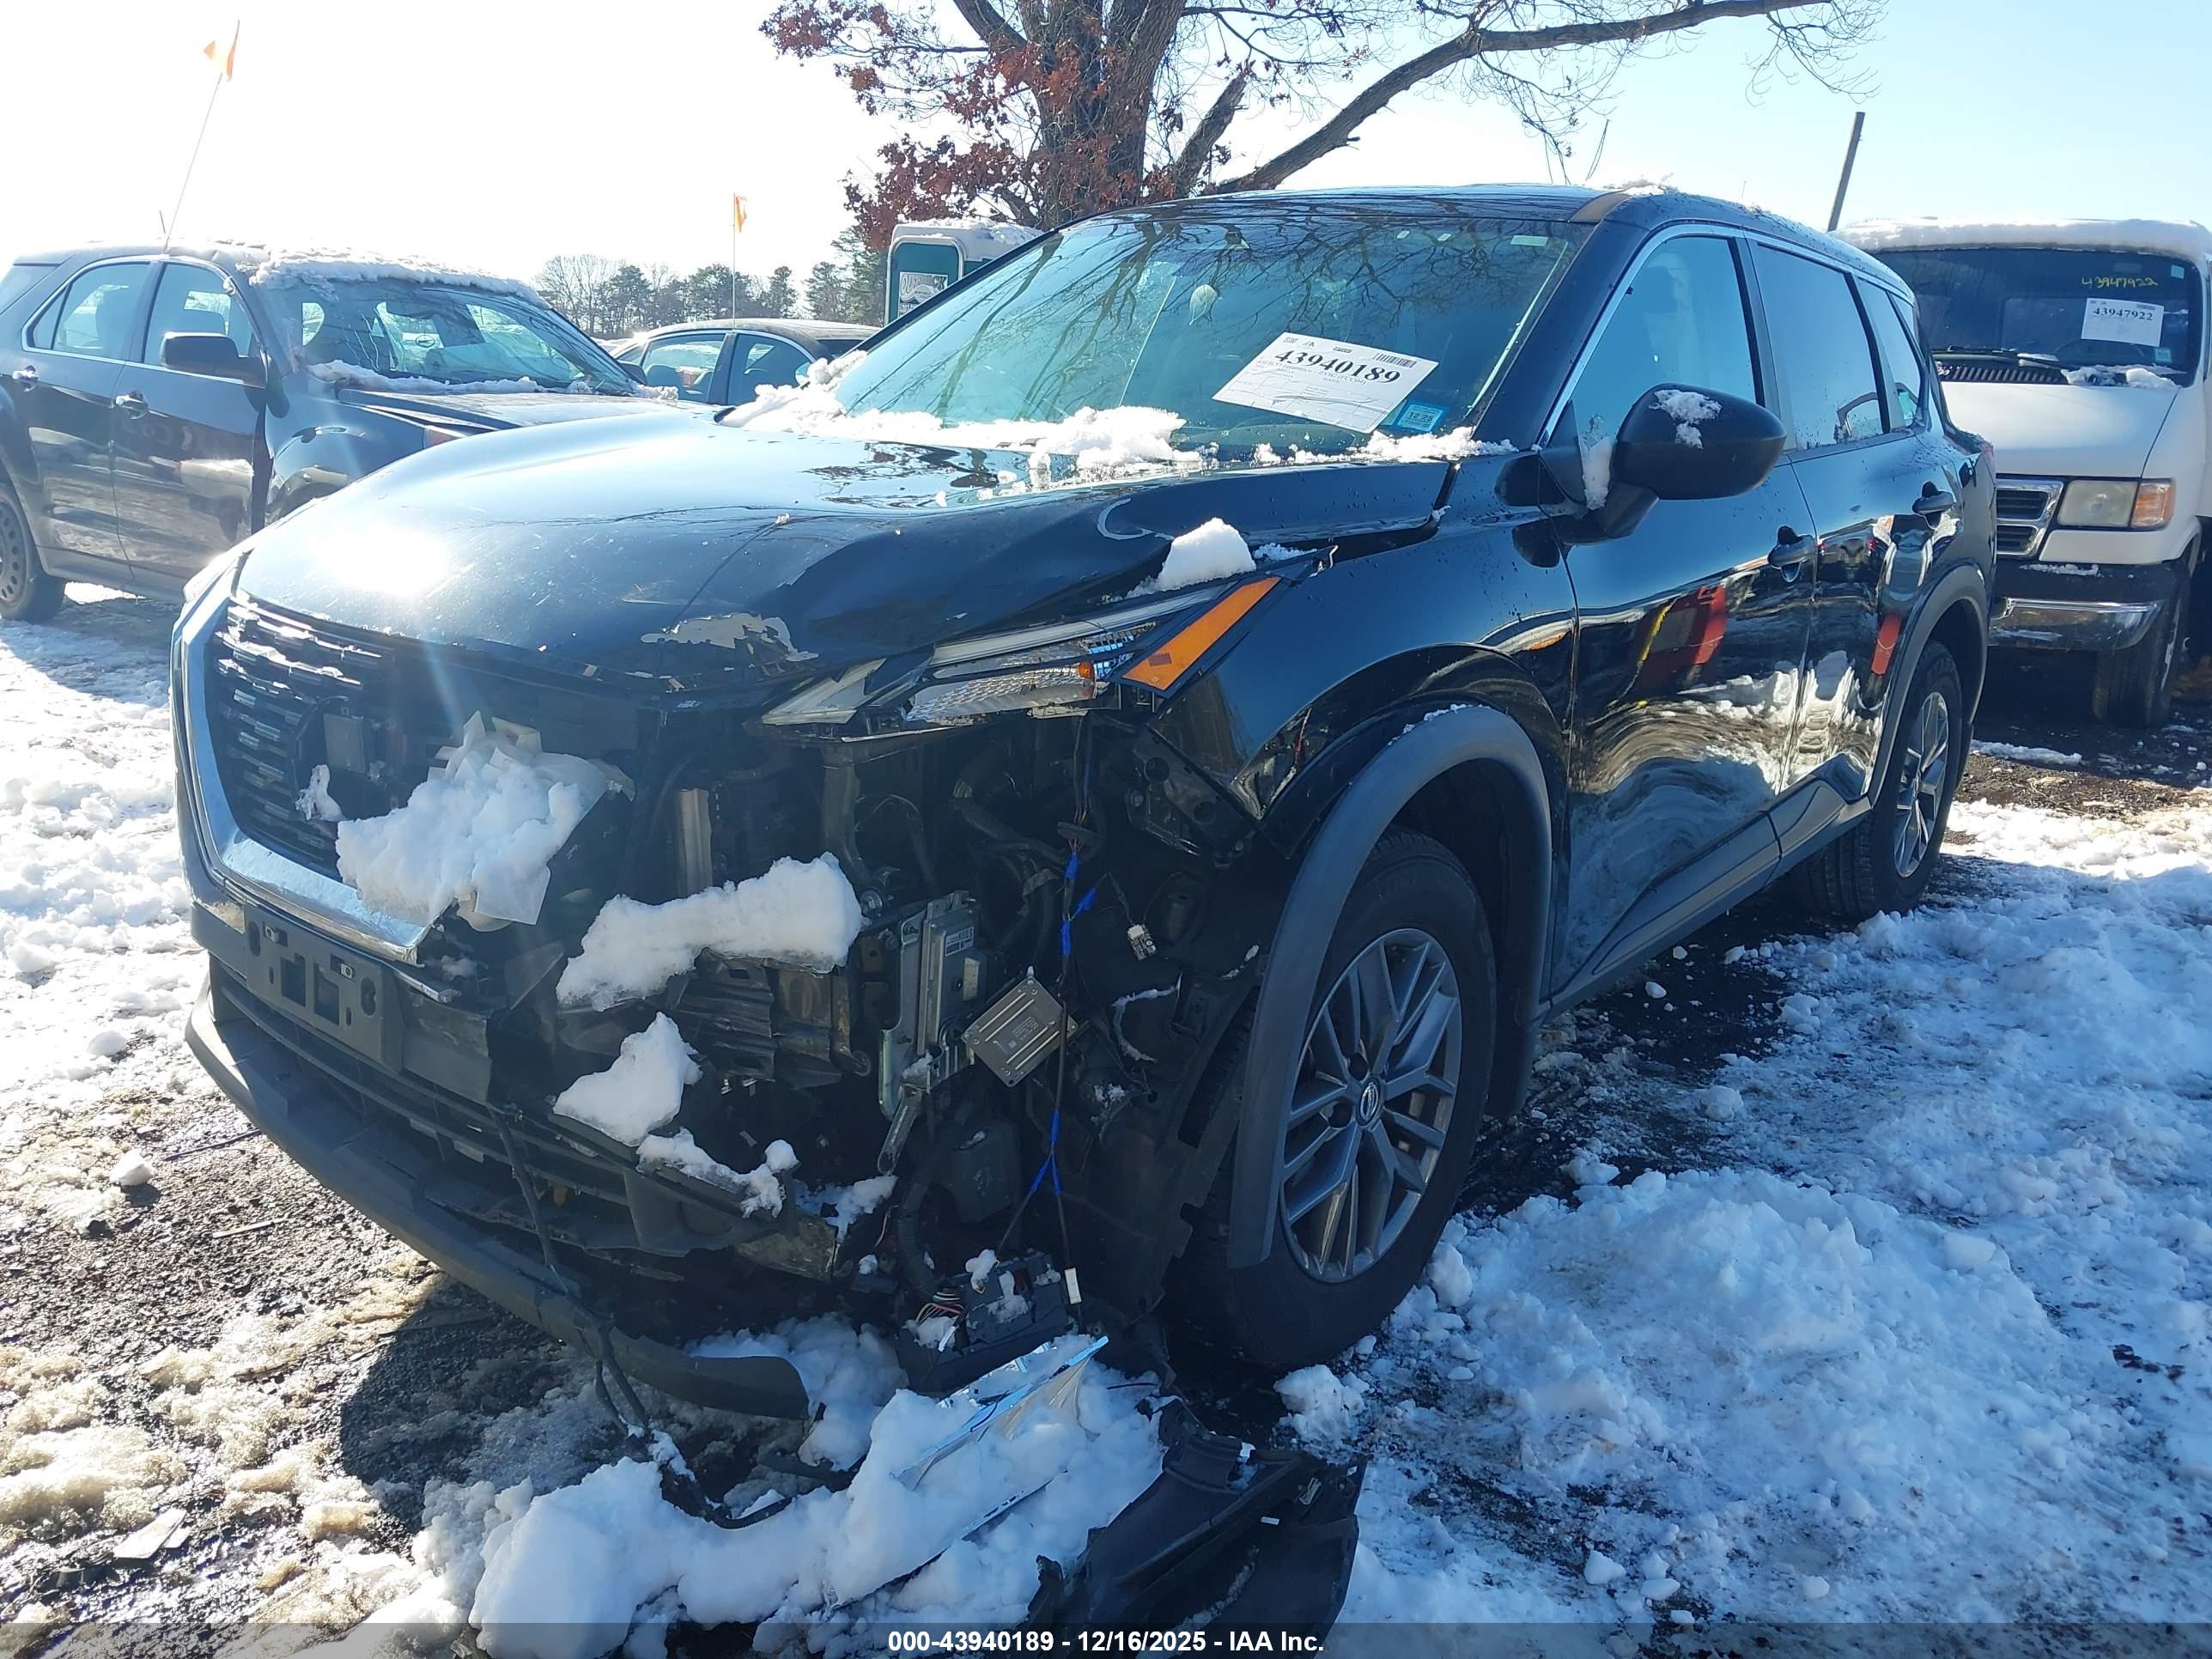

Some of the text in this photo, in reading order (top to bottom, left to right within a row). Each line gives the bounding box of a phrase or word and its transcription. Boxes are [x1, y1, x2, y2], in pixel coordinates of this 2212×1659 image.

[2081, 276, 2159, 289] 43947922
[2094, 307, 2154, 321] 43947922
[1274, 349, 1401, 384] 43940189
